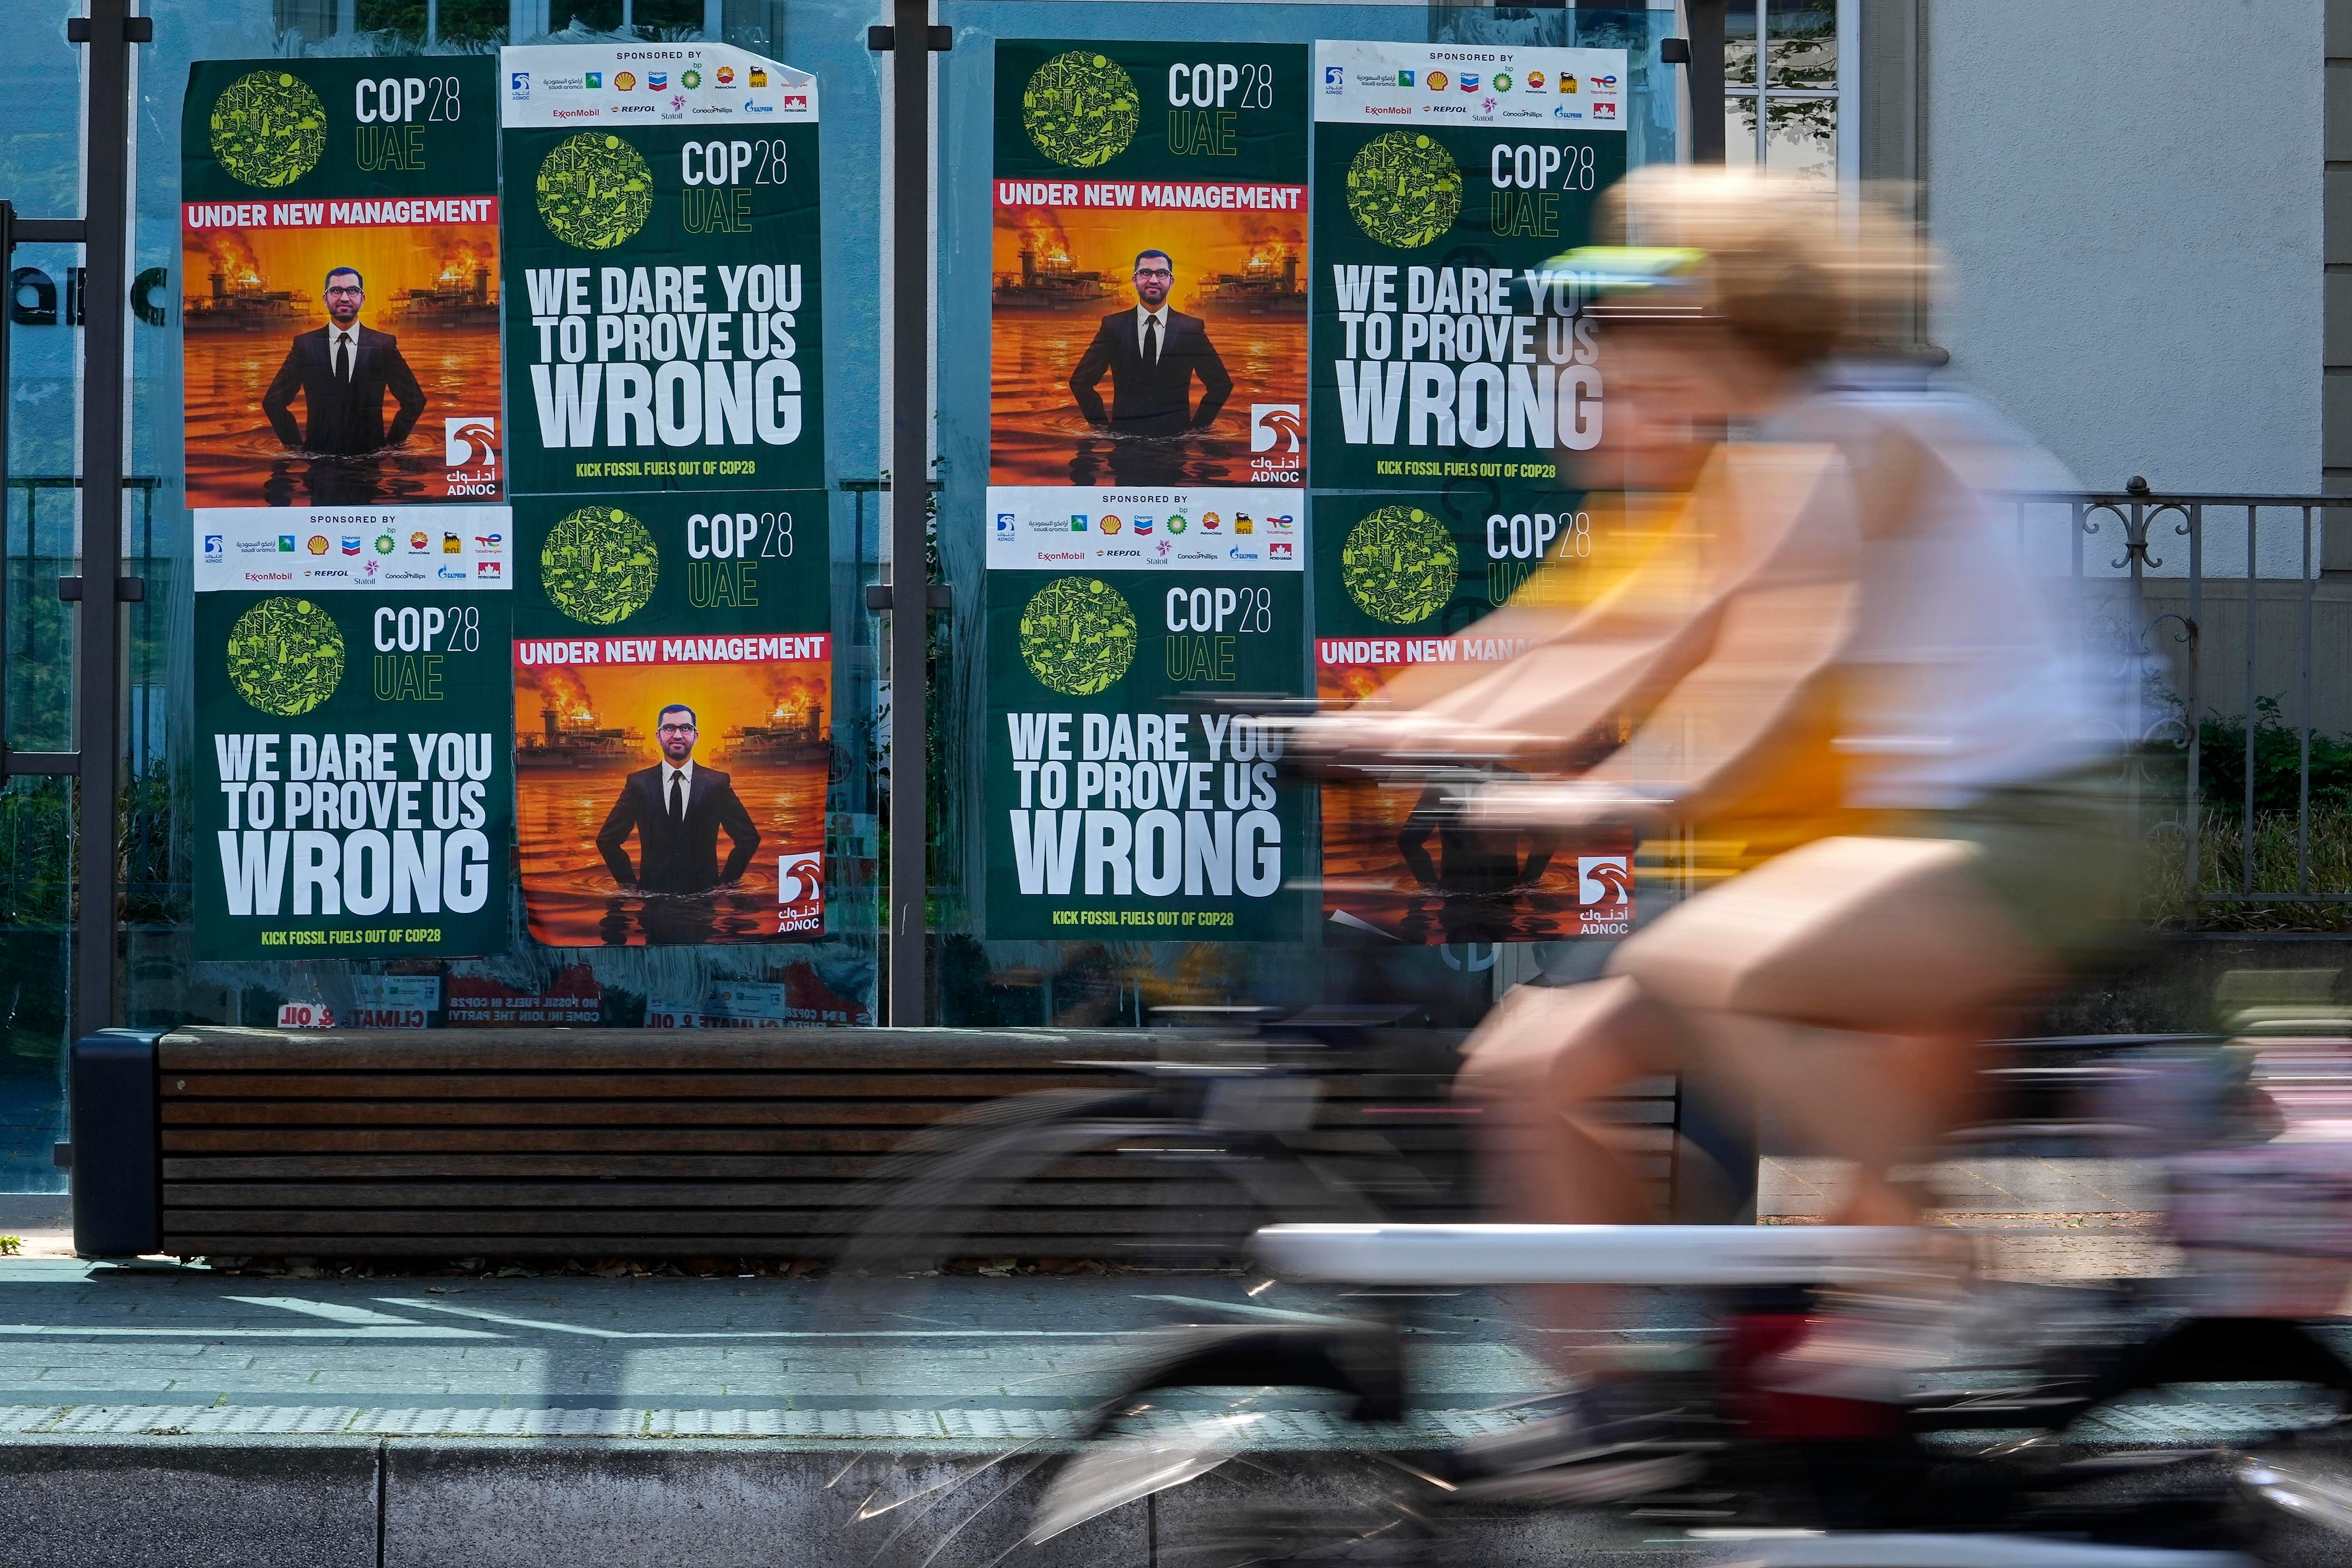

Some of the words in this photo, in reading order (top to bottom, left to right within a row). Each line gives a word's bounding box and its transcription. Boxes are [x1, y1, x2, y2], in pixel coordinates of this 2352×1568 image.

[1430, 53, 1495, 61] SPONSORED
[356, 76, 460, 123] COP28
[1168, 63, 1272, 109] COP28
[553, 109, 599, 119] ExxonMobil
[1168, 111, 1237, 156] UAE
[1366, 106, 1411, 115] ExxonMobil
[356, 126, 425, 170] UAE
[682, 139, 787, 186] COP28
[1491, 144, 1594, 191] COP28
[189, 205, 267, 228] UNDER
[273, 203, 324, 225] NEW
[330, 199, 492, 224] MANAGEMENT
[683, 188, 753, 234] UAE
[1000, 183, 1077, 206] UNDER
[1085, 184, 1135, 207] NEW
[1141, 185, 1301, 209] MANAGEMENT
[1491, 191, 1559, 237] UAE
[524, 267, 591, 315] WE
[601, 265, 707, 314] DARE
[717, 264, 801, 312] YOU
[1333, 264, 1398, 314] WE
[1408, 266, 1513, 315] DARE
[532, 315, 586, 363] TO
[596, 313, 732, 361] PROVE
[742, 312, 796, 360] US
[1339, 313, 1392, 359] TO
[1402, 315, 1536, 363] PROVE
[1547, 318, 1599, 365] US
[530, 359, 801, 448] WRONG
[1335, 359, 1603, 450] WRONG
[447, 484, 496, 496] ADNOC
[577, 463, 603, 477] KICK
[604, 462, 642, 476] FOSSIL
[644, 462, 676, 476] FUELS
[678, 461, 700, 475] OUT
[703, 461, 716, 475] OF
[720, 460, 755, 475] COP28
[1251, 471, 1299, 482] ADNOC
[1377, 461, 1402, 476] KICK
[1405, 462, 1441, 476] FOSSIL
[1445, 463, 1478, 477] FUELS
[1480, 463, 1501, 478] OUT
[1504, 464, 1518, 478] OF
[1520, 464, 1556, 479] COP28
[687, 512, 793, 559] COP28
[1237, 526, 1251, 534] eni
[1487, 512, 1591, 559] COP28
[246, 573, 292, 582] ExxonMobil
[1038, 553, 1084, 561] ExxonMobil
[688, 561, 758, 607] UAE
[1487, 562, 1557, 608] UAE
[374, 606, 479, 652] COP28
[1166, 587, 1271, 633] COP28
[520, 642, 599, 665] UNDER
[605, 640, 656, 663] NEW
[662, 637, 825, 661] MANAGEMENT
[1166, 636, 1235, 681] UAE
[1322, 640, 1400, 664] UNDER
[1407, 640, 1457, 663] NEW
[374, 656, 443, 701] UAE
[214, 734, 280, 781] WE
[290, 733, 397, 781] DARE
[408, 732, 492, 781] YOU
[1007, 713, 1072, 760] WE
[1083, 713, 1189, 761] DARE
[1200, 714, 1284, 762] YOU
[221, 782, 274, 829] TO
[285, 781, 422, 829] PROVE
[433, 781, 485, 829] US
[1013, 761, 1066, 809] TO
[1078, 762, 1213, 809] PROVE
[1224, 763, 1277, 810] US
[218, 829, 489, 915] WRONG
[1009, 809, 1281, 897] WRONG
[262, 931, 287, 945] KICK
[290, 931, 326, 945] FOSSIL
[329, 930, 362, 944] FUELS
[365, 930, 387, 943] OUT
[389, 929, 402, 943] OF
[405, 929, 441, 943] COP28
[778, 918, 819, 932] ADNOC
[1053, 911, 1078, 924] KICK
[1081, 911, 1118, 925] FOSSIL
[1121, 911, 1155, 925] FUELS
[1157, 911, 1179, 926] OUT
[1181, 912, 1195, 926] OF
[1198, 912, 1234, 926] COP28
[1580, 923, 1628, 935] ADNOC
